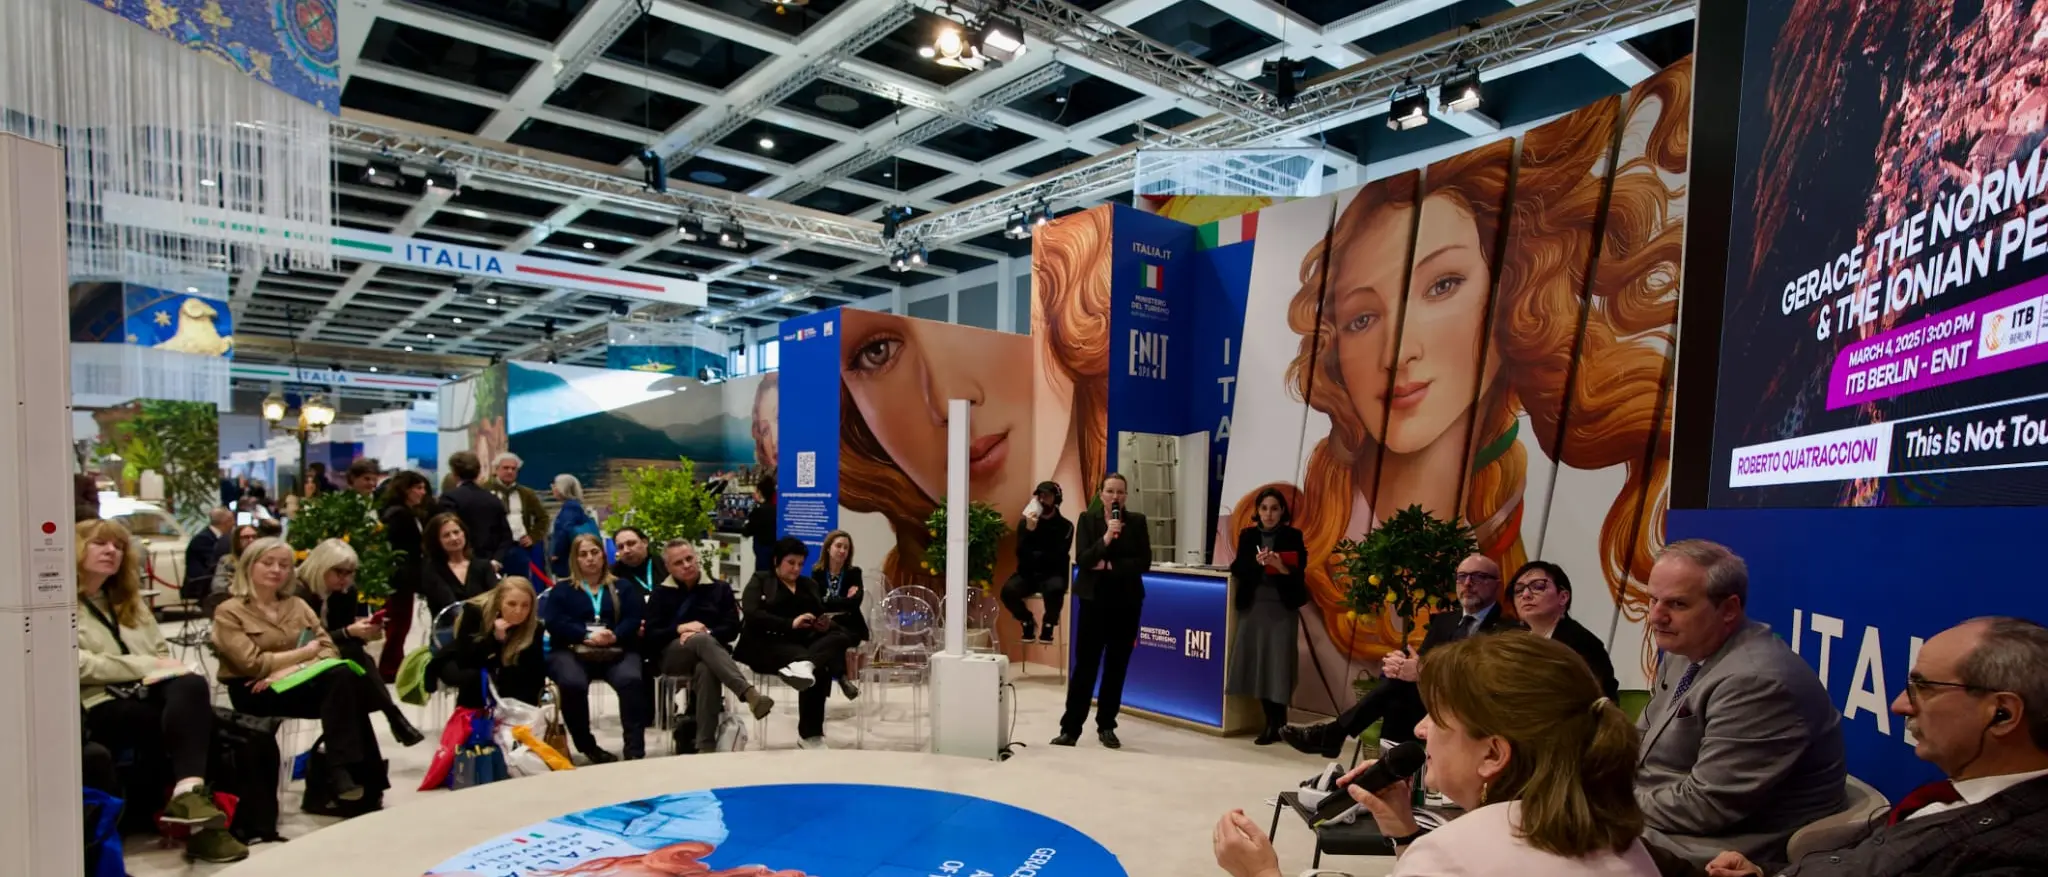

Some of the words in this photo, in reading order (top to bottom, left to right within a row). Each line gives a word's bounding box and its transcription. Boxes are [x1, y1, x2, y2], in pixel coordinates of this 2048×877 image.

[406, 243, 502, 274] ITALIA
[1132, 241, 1172, 260] ITALIA.IT
[1782, 244, 1868, 315] GERACE,
[1874, 210, 1927, 272] THE
[1817, 304, 1831, 341] &
[1837, 281, 1882, 334] THE
[1884, 230, 1993, 315] IONIAN
[2011, 305, 2035, 329] ITB
[1128, 328, 1169, 380] ENIT
[1849, 341, 1884, 368] MARCH
[1895, 329, 1921, 354] 2025
[1926, 319, 1952, 343] 3:00
[1953, 311, 1975, 335] PM
[297, 368, 347, 384] ITALIA
[1845, 371, 1867, 396] ITB
[1867, 355, 1919, 391] BERLIN
[1930, 339, 1973, 375] ENIT
[1737, 452, 1780, 475] ROBERTO
[1782, 437, 1878, 474] QUATRACCIONI
[1906, 425, 1943, 458] This
[1944, 425, 1961, 455] Is
[1964, 419, 2006, 452] Not
[1185, 628, 1212, 659] ENIT
